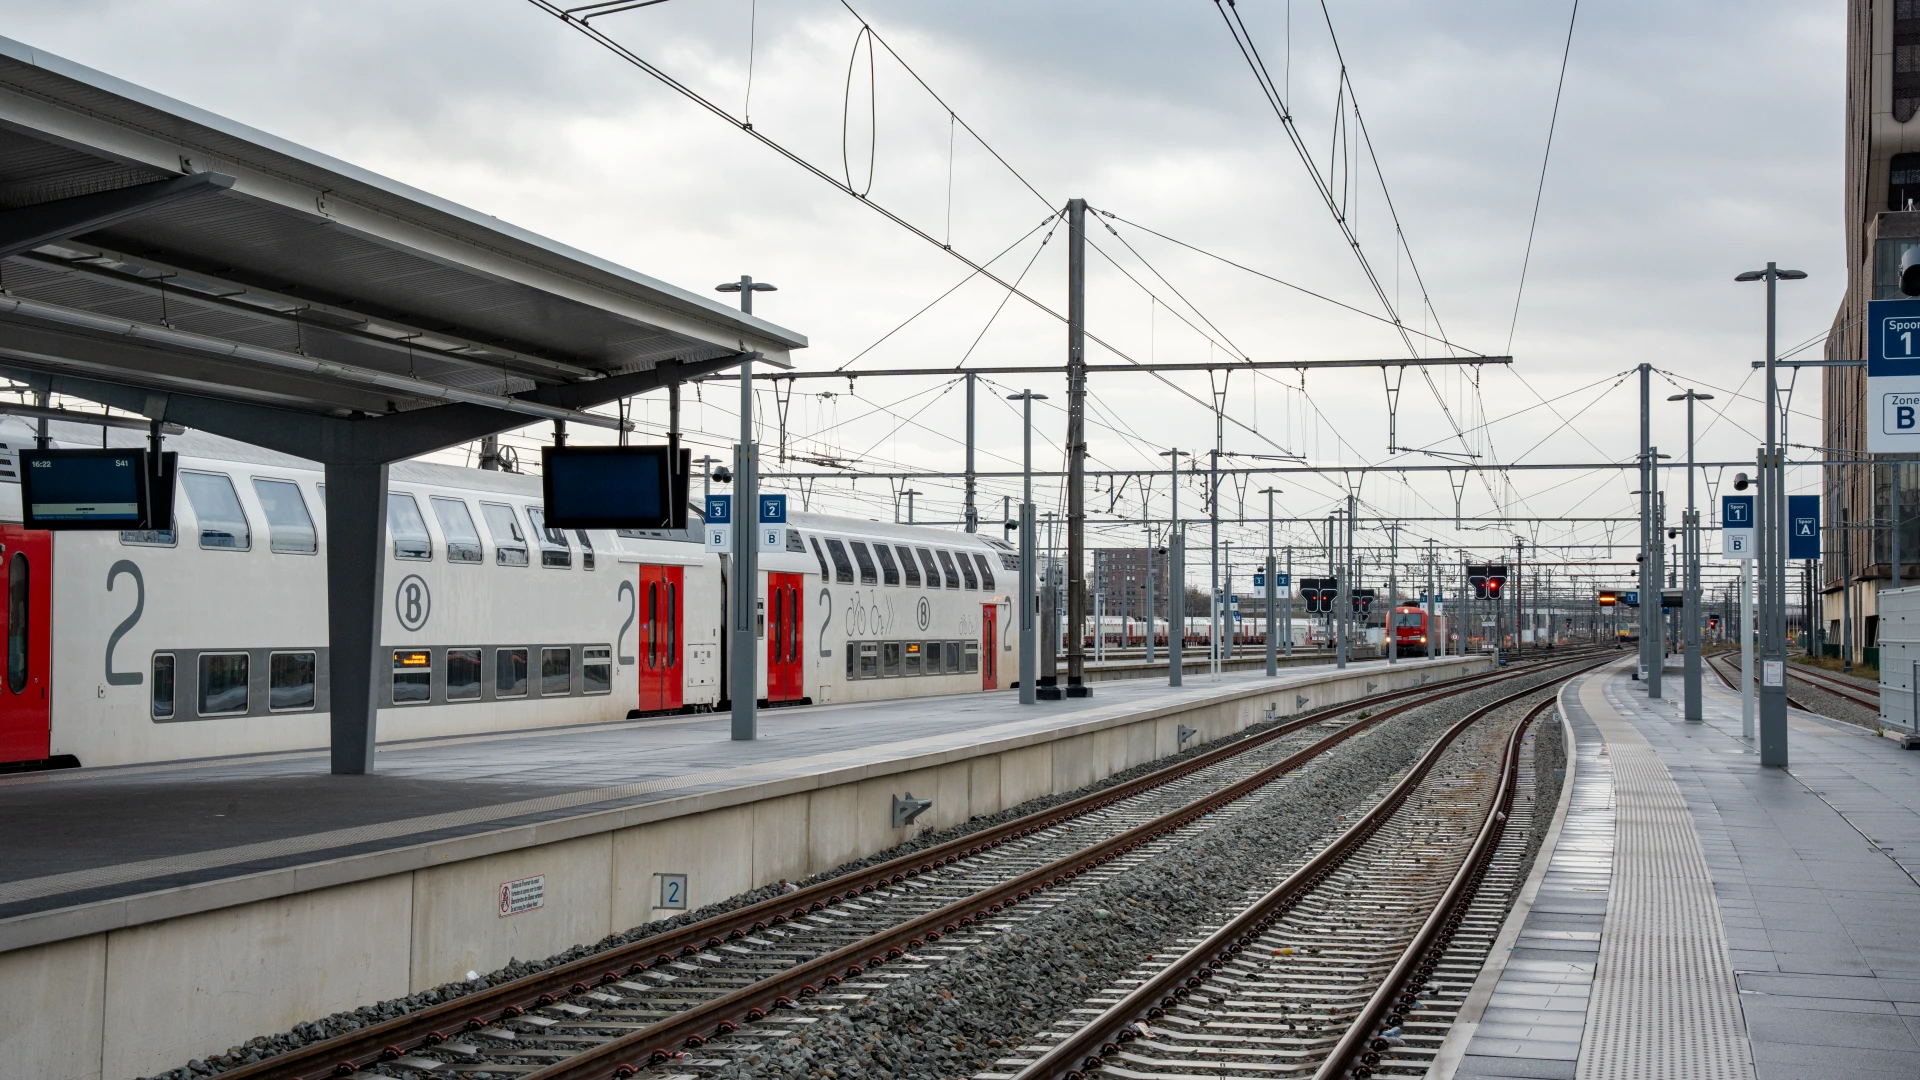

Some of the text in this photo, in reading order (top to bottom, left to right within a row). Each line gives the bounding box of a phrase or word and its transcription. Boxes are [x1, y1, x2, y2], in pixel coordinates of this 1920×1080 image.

[1900, 331, 1912, 355] 1
[1892, 395, 1920, 405] Zone
[1897, 406, 1915, 429] B
[115, 459, 129, 467] S41
[715, 507, 722, 516] 3
[769, 506, 776, 516] 2
[1734, 509, 1740, 520] 1
[1801, 524, 1811, 535] A
[714, 534, 722, 544] B
[769, 534, 776, 544] B
[1733, 540, 1742, 550] B
[105, 559, 145, 686] 2
[617, 579, 636, 666] 2
[819, 587, 832, 658] 2
[1004, 596, 1012, 652] 2
[668, 881, 679, 903] 2
